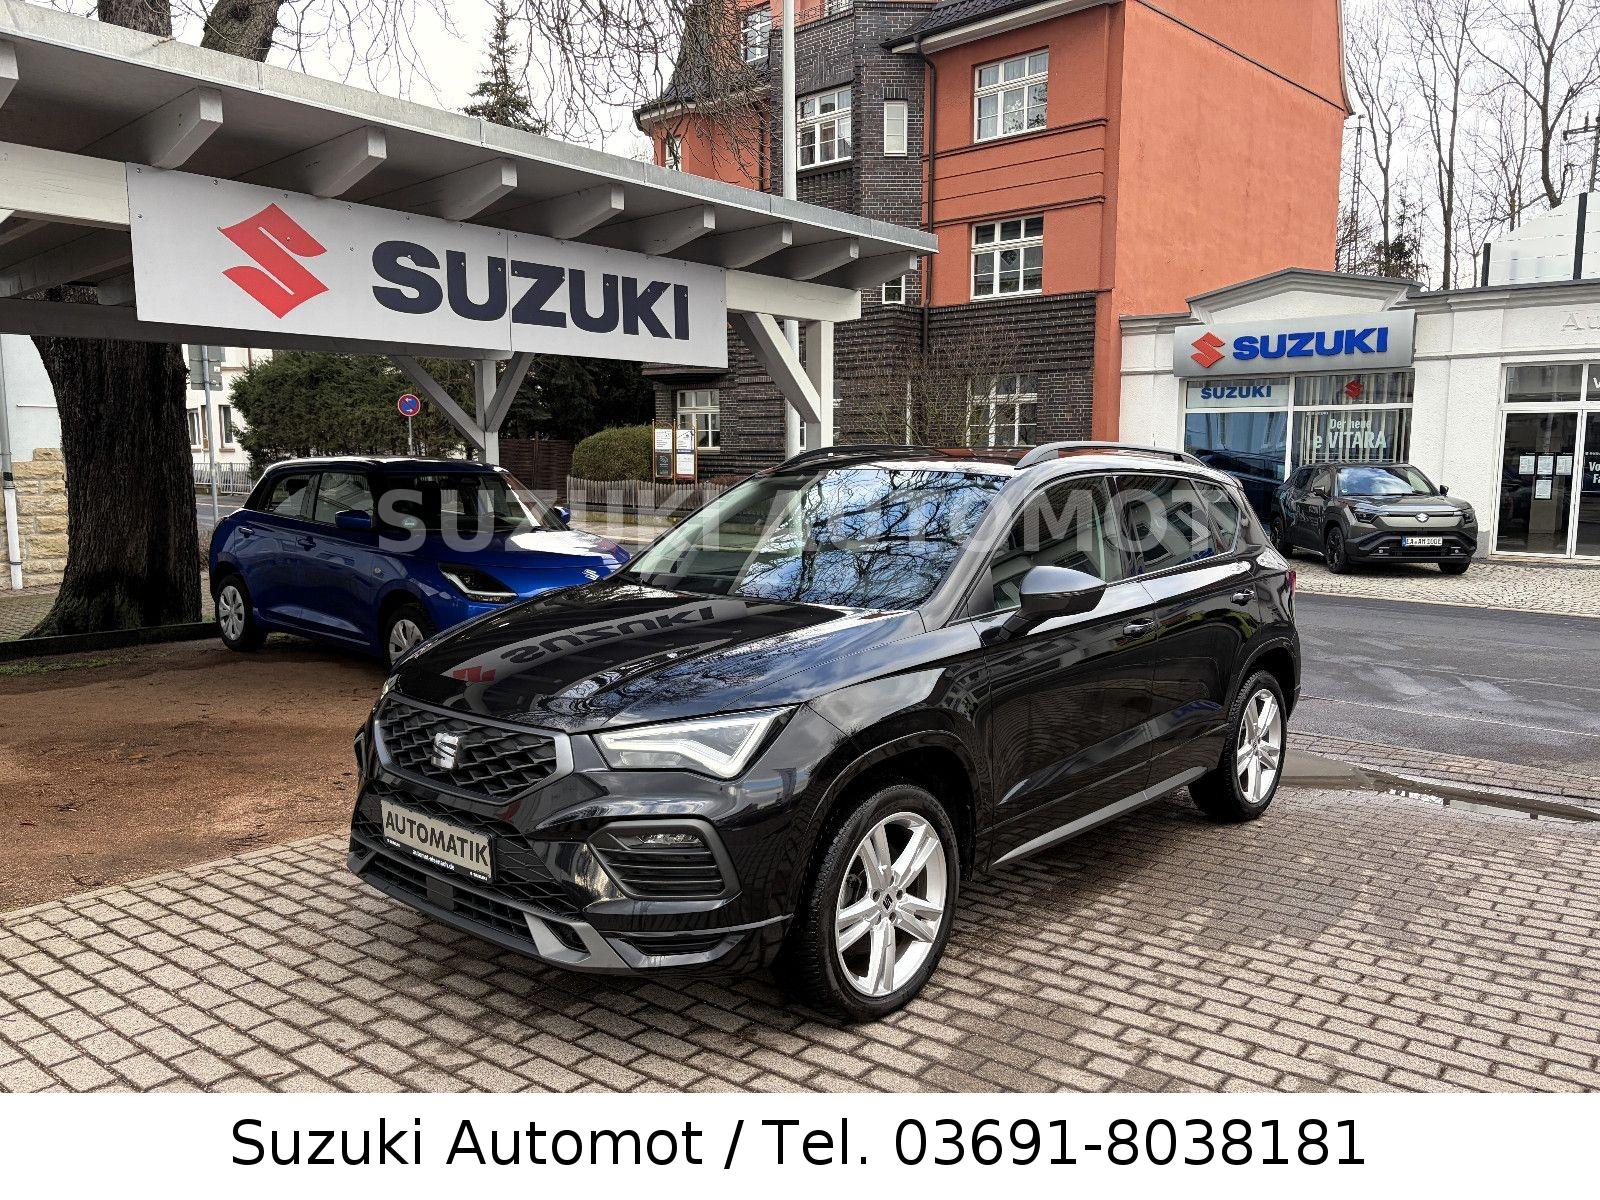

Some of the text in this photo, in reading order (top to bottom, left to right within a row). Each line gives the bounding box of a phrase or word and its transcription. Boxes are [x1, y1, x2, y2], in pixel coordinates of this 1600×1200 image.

[371, 239, 690, 340] SUZUKI
[1232, 326, 1389, 361] SUZUKI
[1200, 384, 1272, 400] SUZUKI
[1329, 418, 1372, 430] Der neue
[1313, 430, 1387, 449] e VITARA
[385, 810, 489, 867] AUTOMATIK
